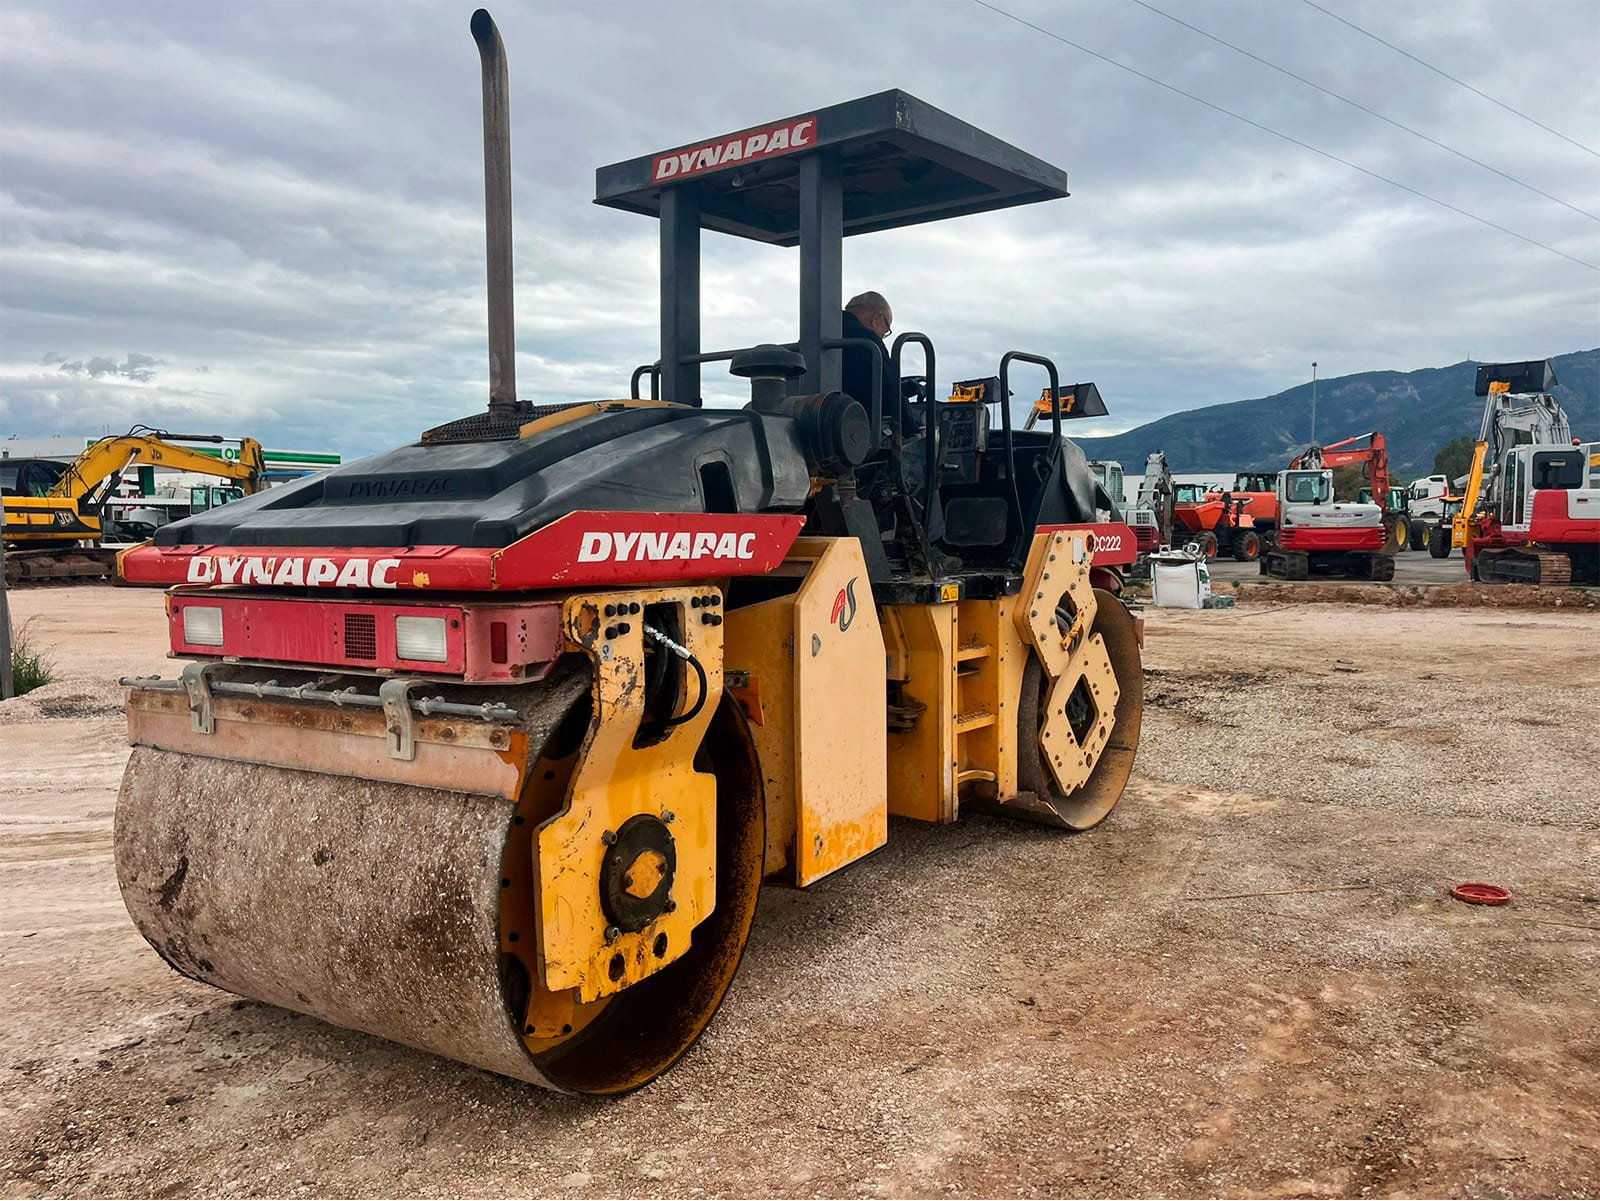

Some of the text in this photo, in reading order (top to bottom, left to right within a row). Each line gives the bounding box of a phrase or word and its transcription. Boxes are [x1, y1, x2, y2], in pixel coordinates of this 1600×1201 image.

[655, 120, 812, 180] DYNAPAC
[348, 478, 456, 498] DYNAPAC
[577, 532, 756, 563] DYNAPAC
[187, 555, 401, 589] DYNAPAC
